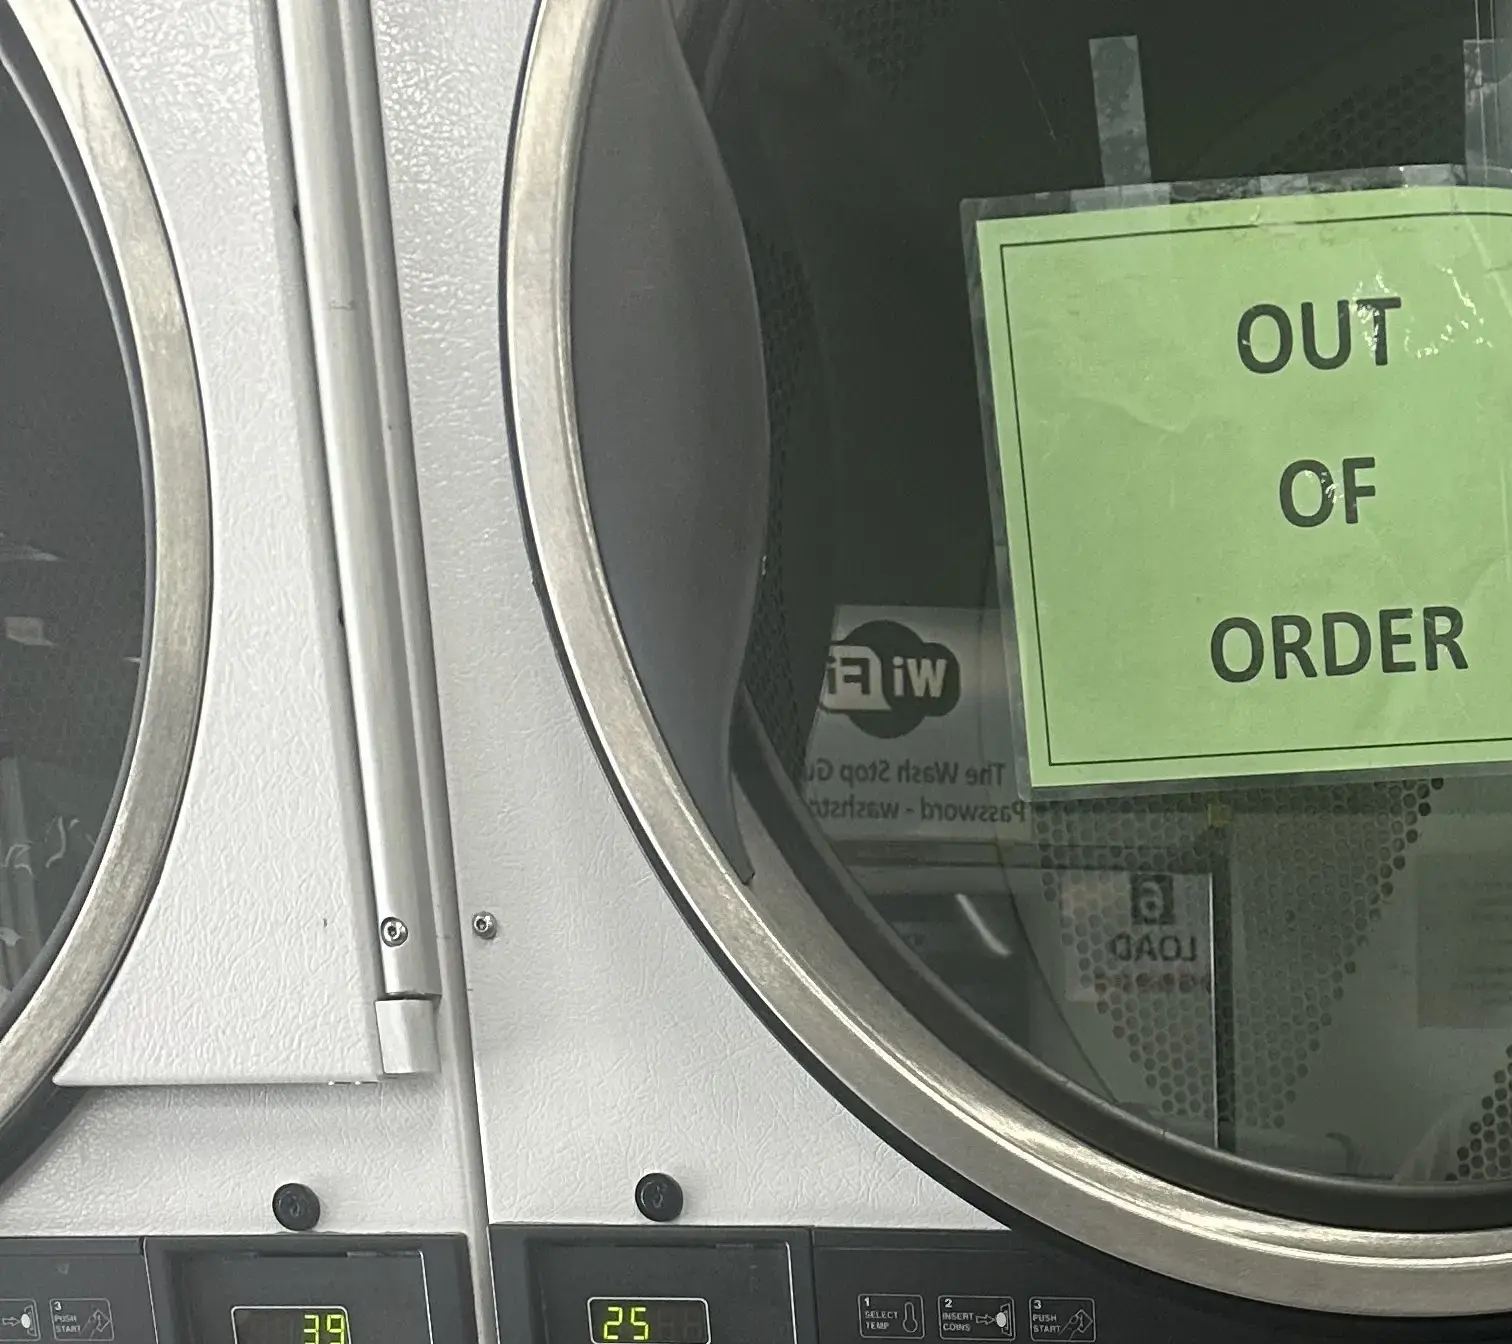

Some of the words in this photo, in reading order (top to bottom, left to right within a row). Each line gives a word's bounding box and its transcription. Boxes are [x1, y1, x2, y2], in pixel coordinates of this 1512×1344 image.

[1236, 296, 1402, 375] OUT
[1278, 456, 1377, 528] OF
[1210, 605, 1470, 684] ORDER
[54, 1301, 62, 1311] 3
[944, 1298, 953, 1308] 2
[1033, 1300, 1042, 1310] 3
[54, 1315, 77, 1323] PUSH
[864, 1311, 899, 1320] SELECT
[942, 1312, 974, 1320] INSERT
[1032, 1313, 1057, 1322] PUSH
[603, 1306, 649, 1340] 25
[943, 1323, 971, 1331] COINS
[1033, 1323, 1061, 1333] START
[56, 1325, 81, 1333] START
